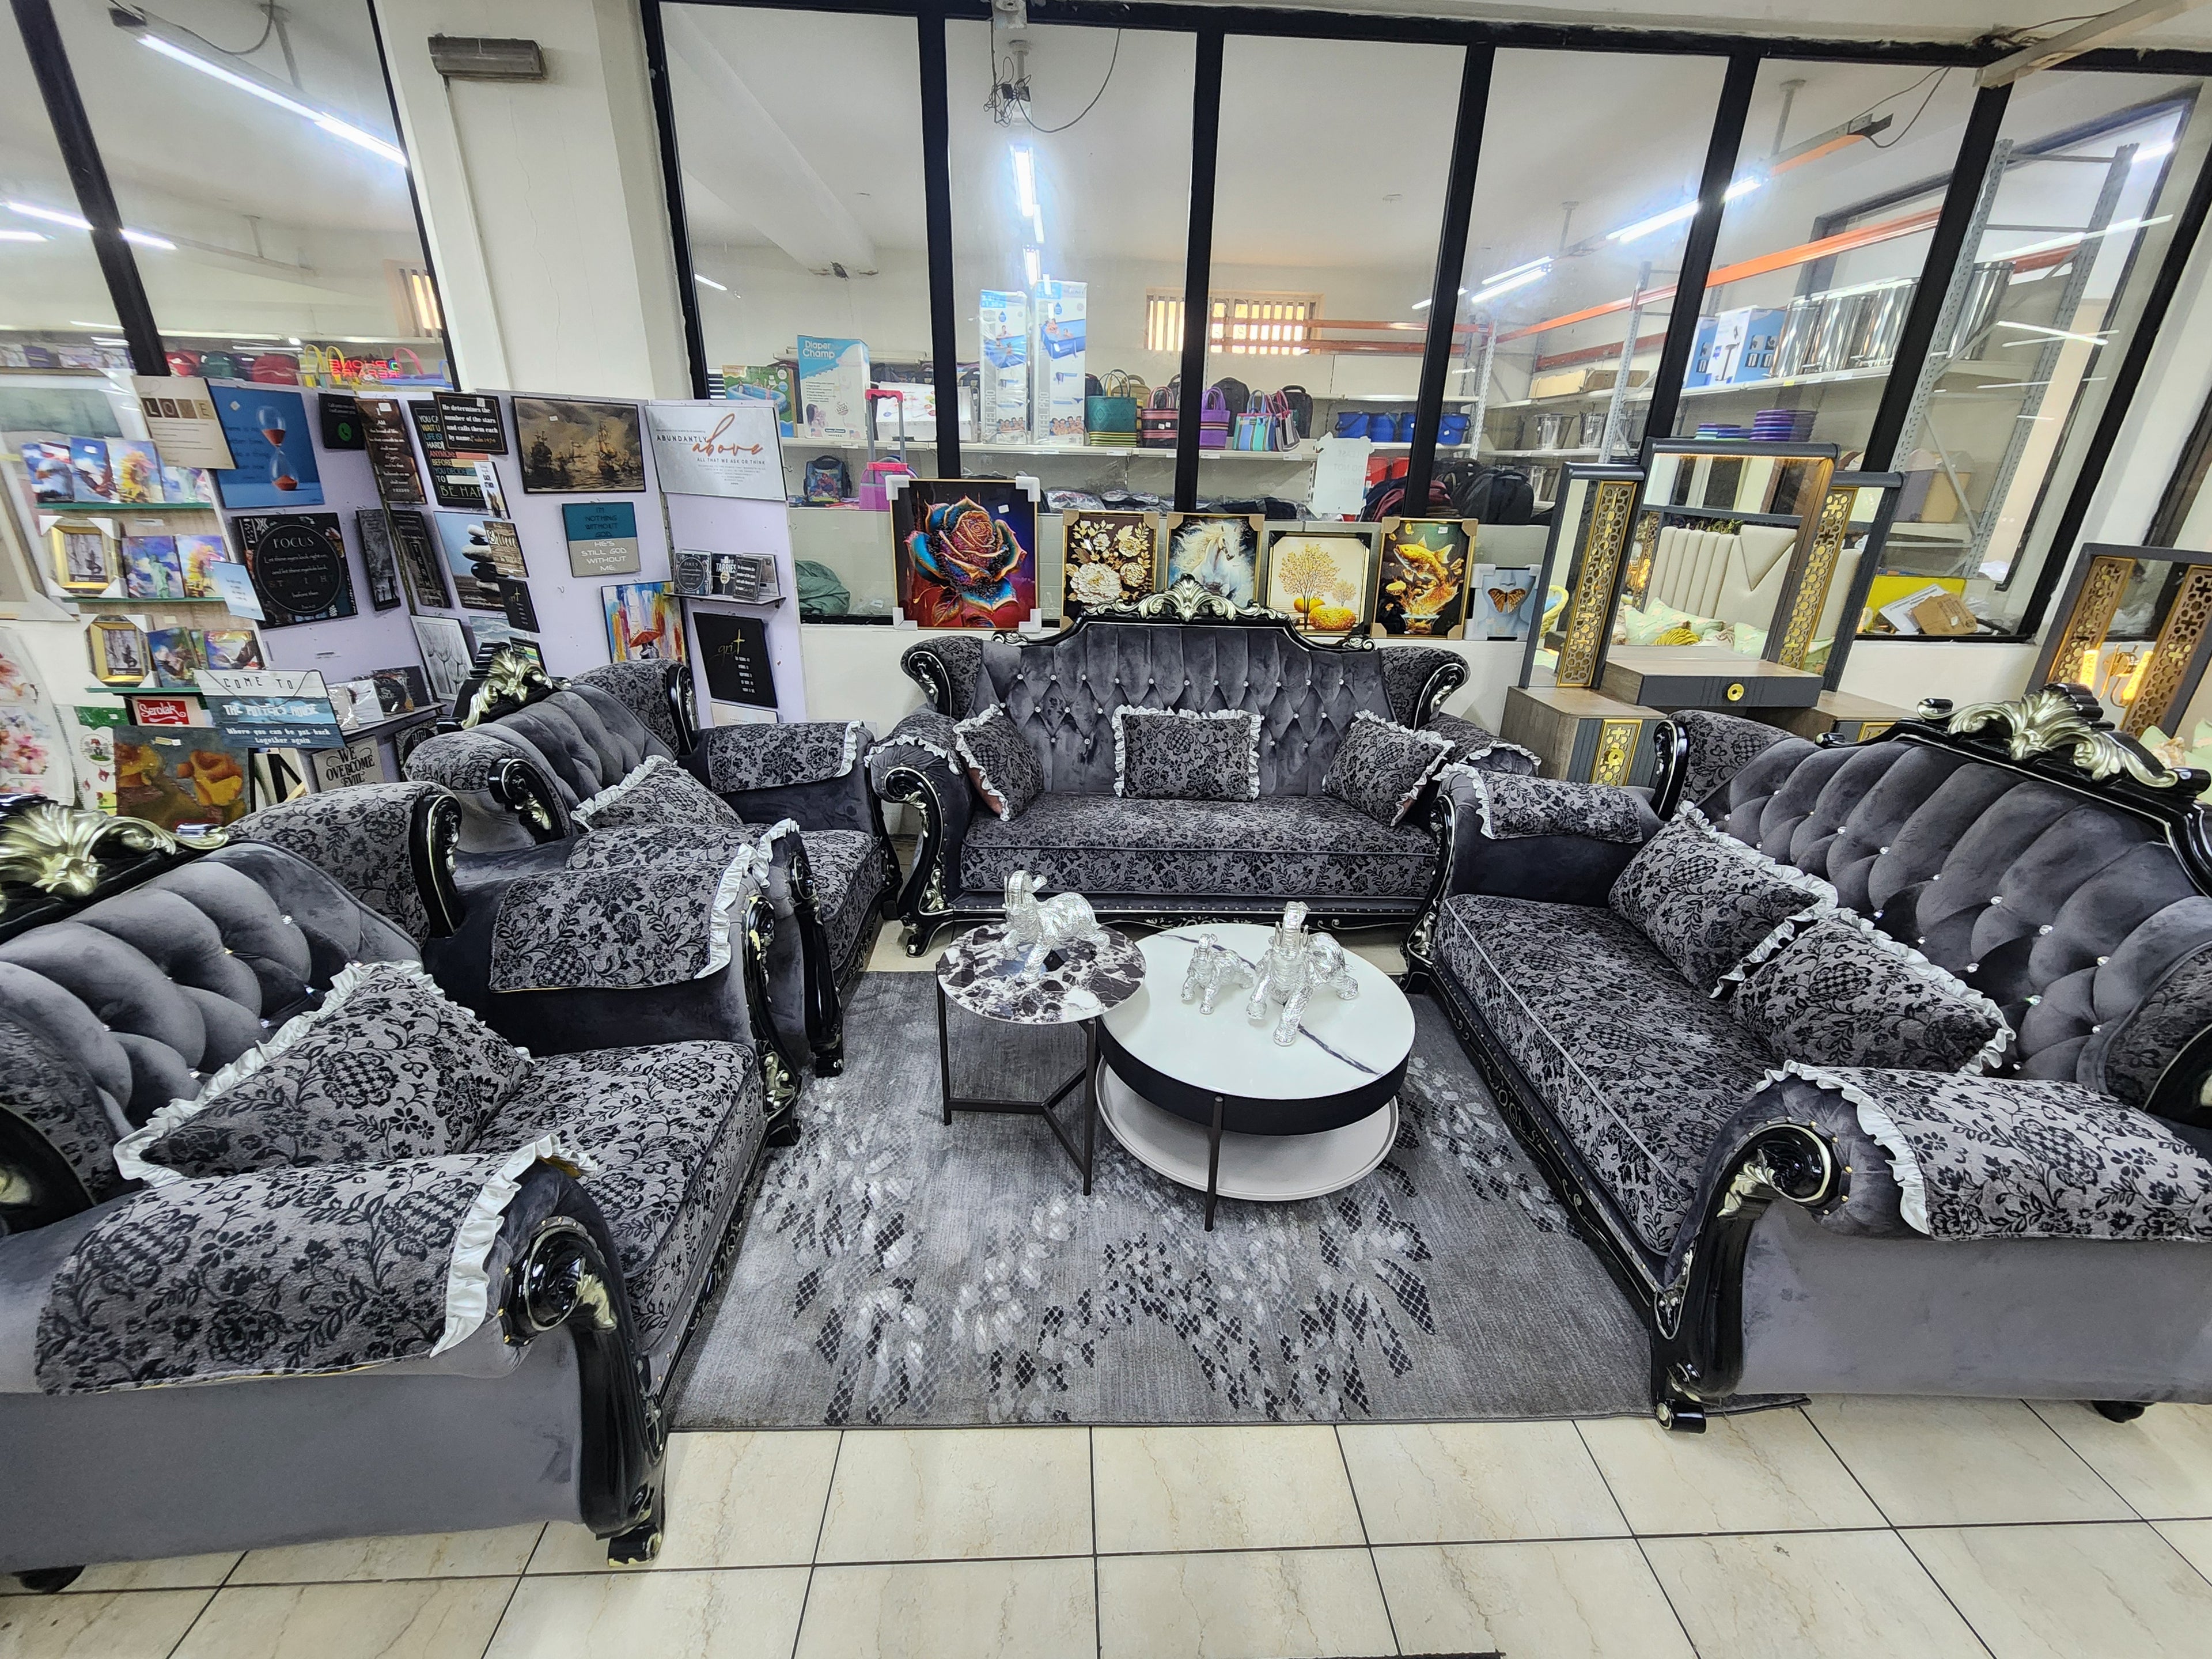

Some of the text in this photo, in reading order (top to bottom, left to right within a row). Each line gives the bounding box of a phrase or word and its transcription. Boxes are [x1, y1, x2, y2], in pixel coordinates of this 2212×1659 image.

[805, 340, 831, 350] Diaper
[802, 349, 835, 359] Champ
[986, 389, 996, 408] PRO
[1039, 392, 1050, 409] PRO
[1039, 411, 1050, 438] STEEL
[692, 413, 763, 457] above
[440, 485, 458, 497] BE
[273, 536, 315, 548] FOCUS
[586, 556, 626, 564] WITHOUT
[715, 563, 737, 573] TARRIES
[718, 628, 745, 658] grit
[222, 676, 294, 689] COME TO
[139, 702, 186, 717] Serolak
[222, 704, 243, 715] THE
[290, 704, 319, 717] HOUSE
[298, 729, 309, 737] put
[411, 729, 427, 746] FAITH
[337, 746, 357, 763] WE
[325, 754, 375, 781] OVERCOME
[340, 771, 365, 787] EVIL
